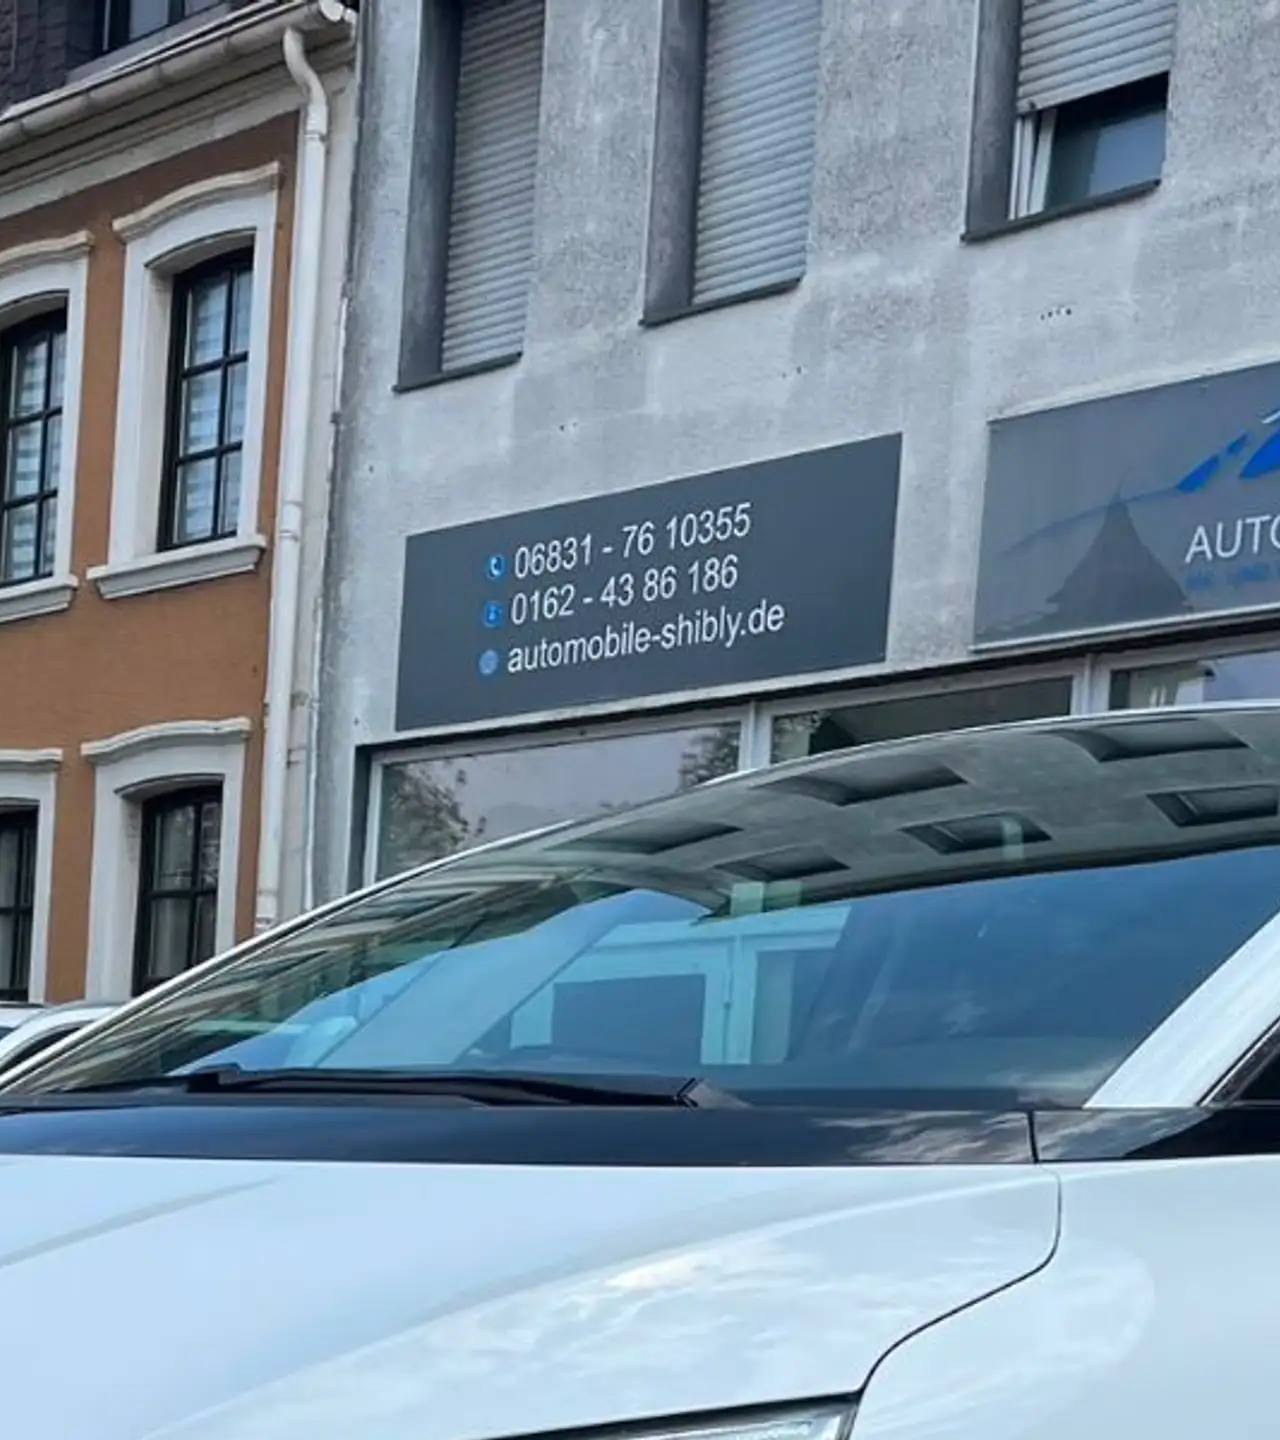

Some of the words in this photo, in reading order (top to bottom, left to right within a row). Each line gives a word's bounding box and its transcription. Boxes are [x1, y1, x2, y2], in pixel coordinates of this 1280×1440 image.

[514, 532, 593, 579] 06831
[622, 521, 656, 559] 76
[666, 502, 752, 550] 10355
[510, 584, 576, 625] 0162
[599, 573, 635, 607] 43
[642, 565, 677, 602] 86
[688, 554, 739, 595] 186
[507, 598, 786, 673] automobile-shibly.de
